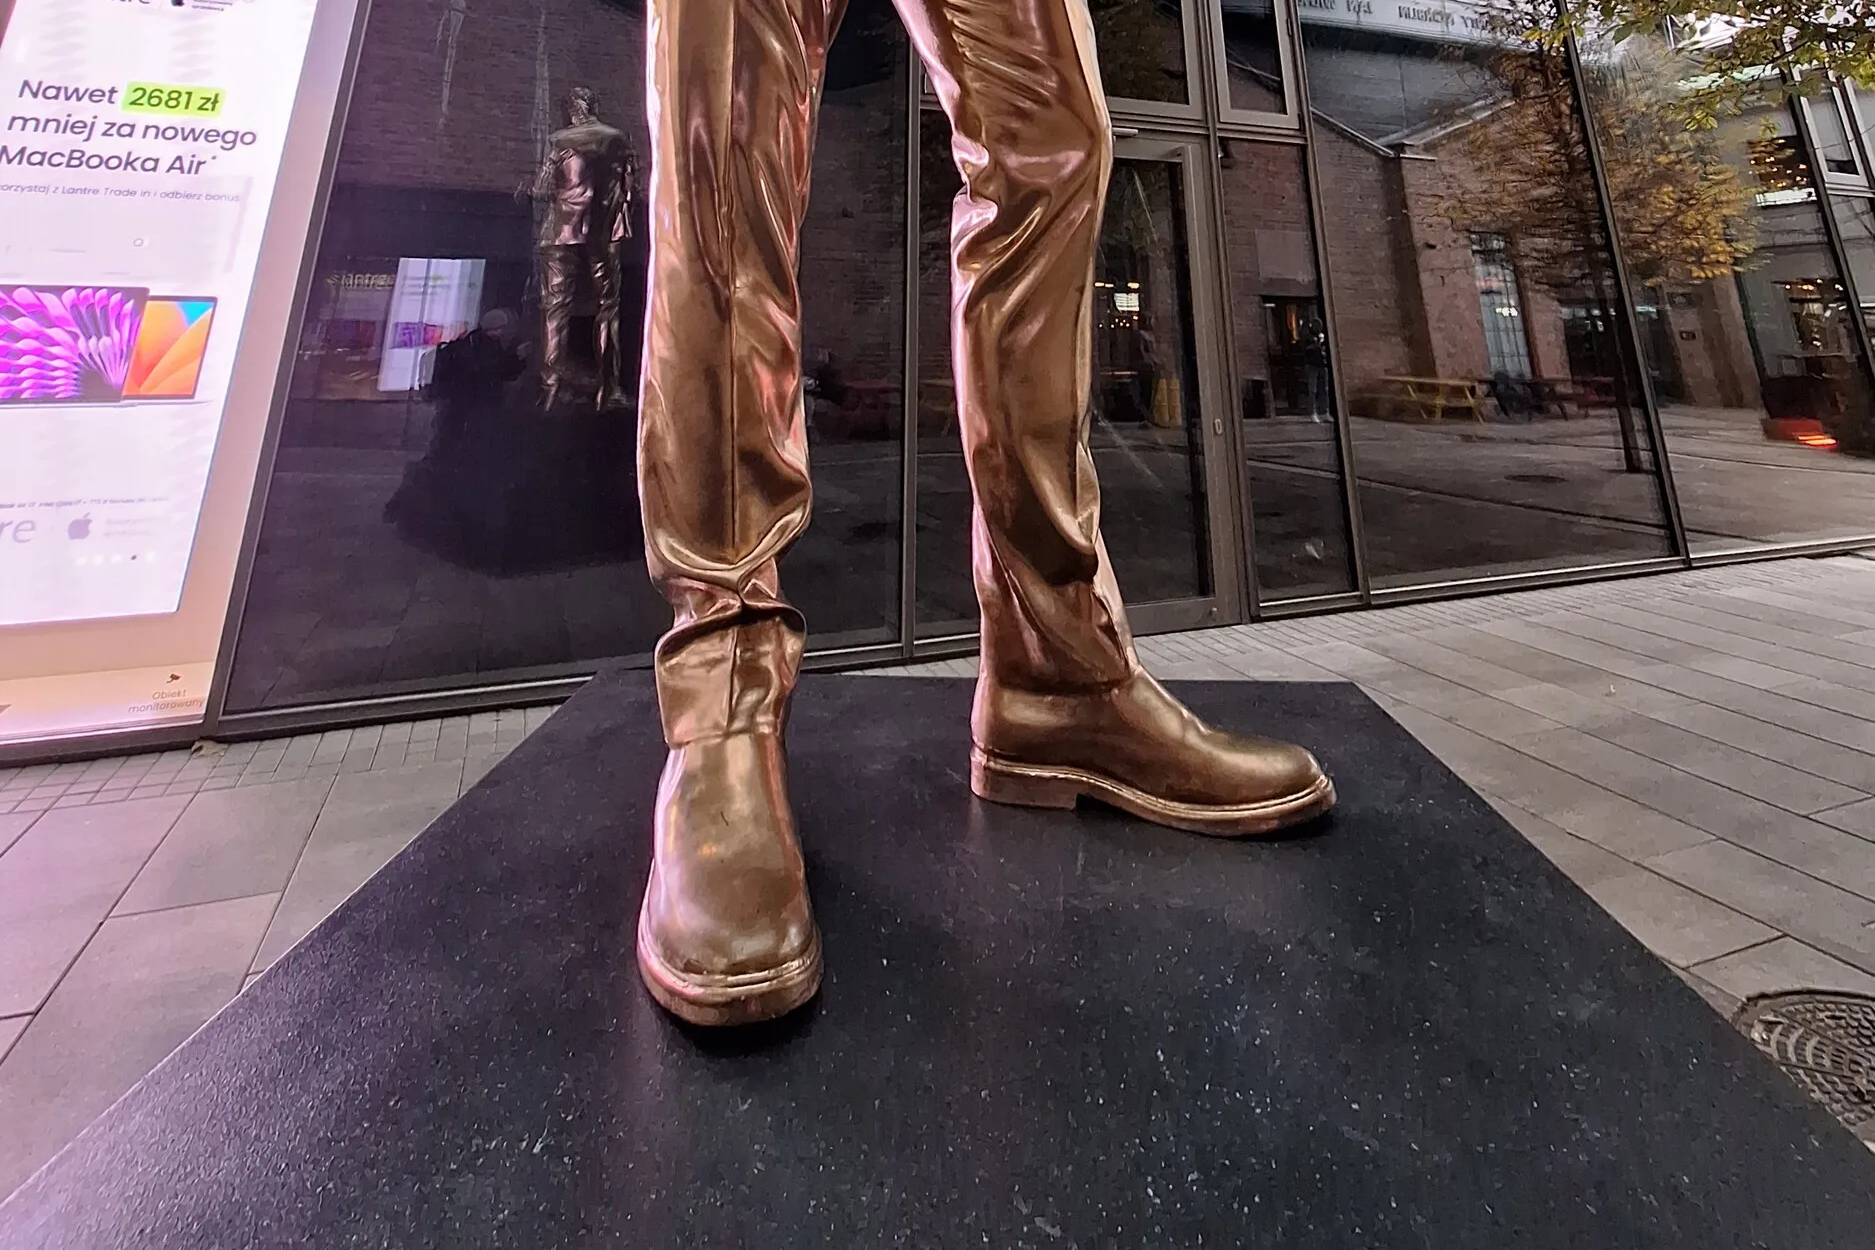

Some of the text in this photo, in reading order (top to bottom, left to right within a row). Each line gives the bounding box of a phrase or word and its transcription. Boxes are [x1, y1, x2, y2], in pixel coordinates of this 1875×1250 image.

[18, 80, 220, 112] Nawet 2681 zł
[7, 114, 257, 151] mniej za nowego
[0, 145, 160, 173] MacBooka
[52, 187, 59, 195] z
[62, 186, 99, 196] Lantre
[104, 187, 137, 198] Trade
[160, 190, 201, 200] odbierz
[205, 192, 240, 203] bonus
[152, 689, 186, 700] Obiekt
[128, 699, 204, 713] monitorowany
